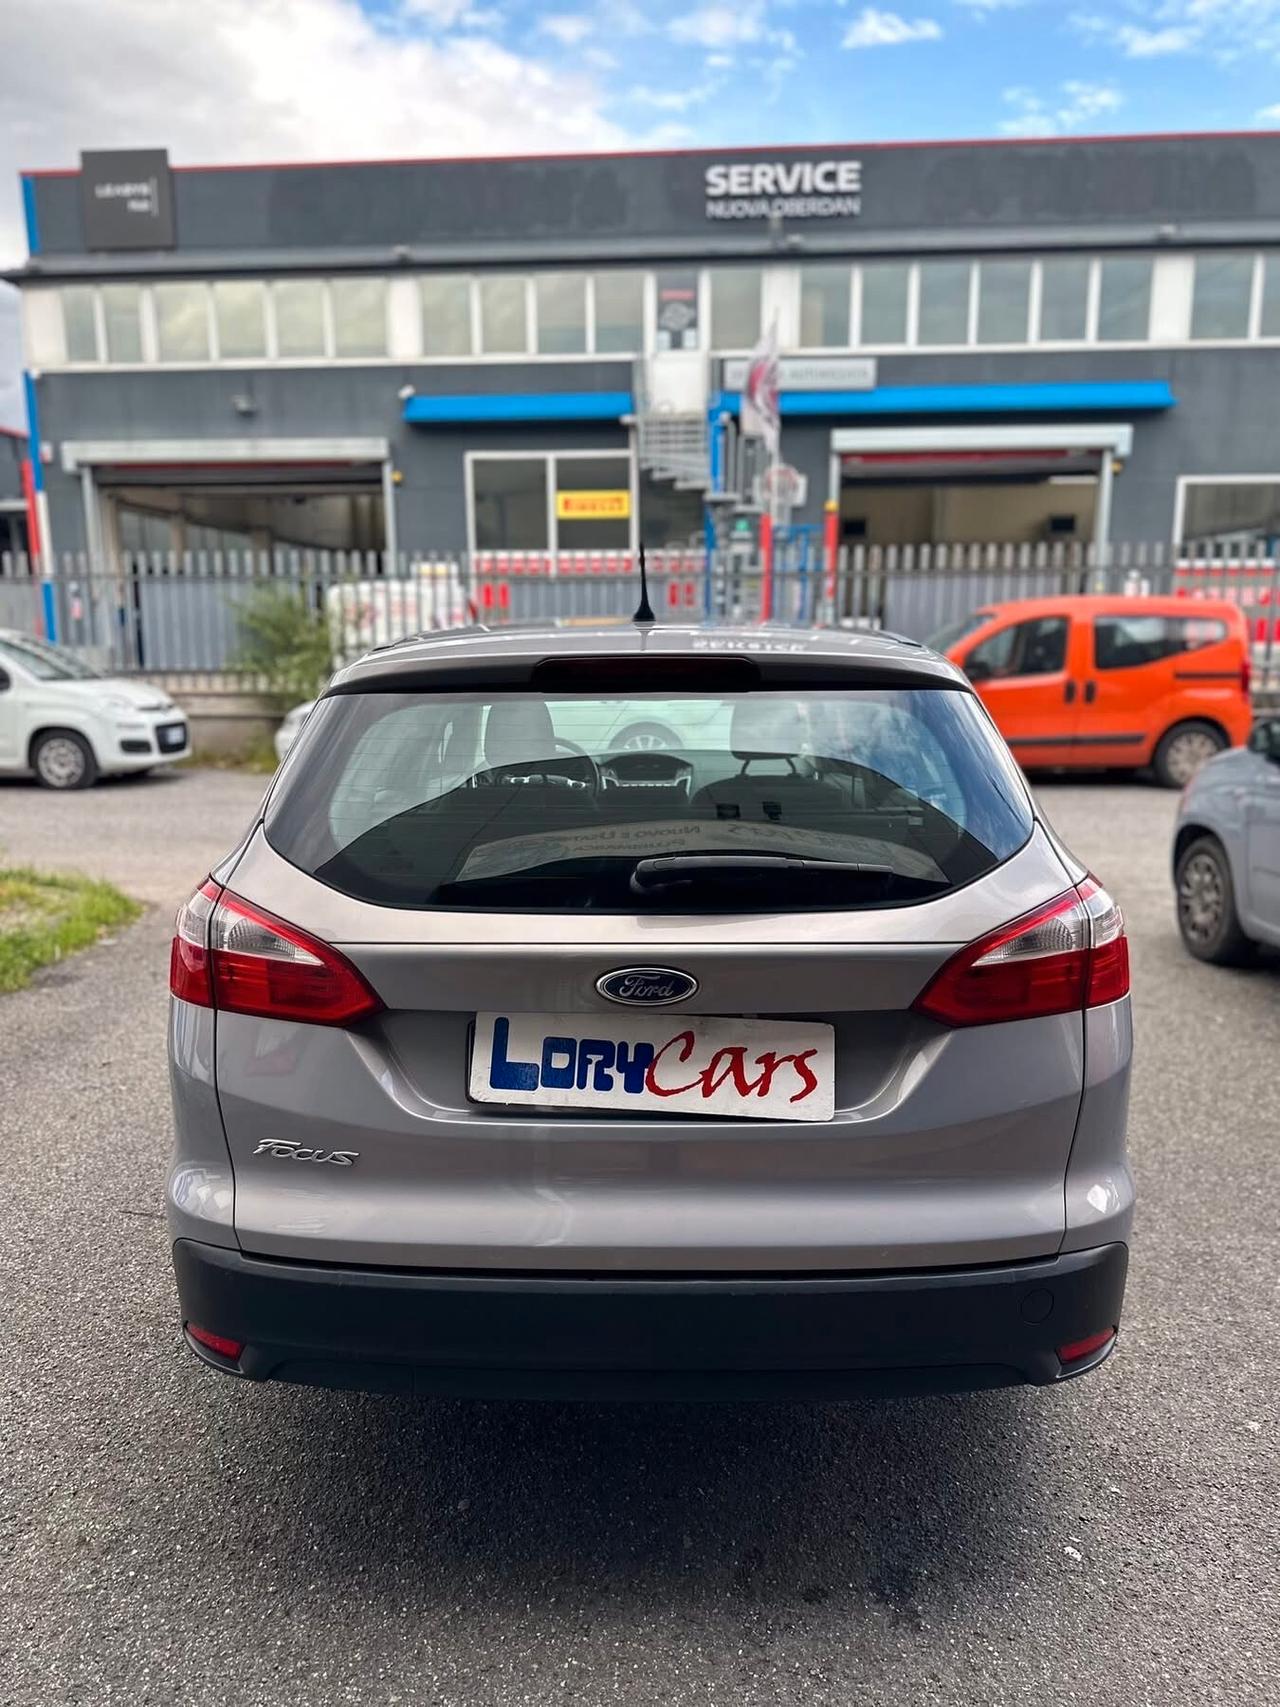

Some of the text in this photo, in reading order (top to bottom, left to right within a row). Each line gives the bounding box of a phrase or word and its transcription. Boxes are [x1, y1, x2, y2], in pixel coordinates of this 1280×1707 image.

[705, 160, 863, 197] SERVICE
[705, 197, 862, 219] NUOVA OBERDAN
[618, 974, 675, 997] Ford
